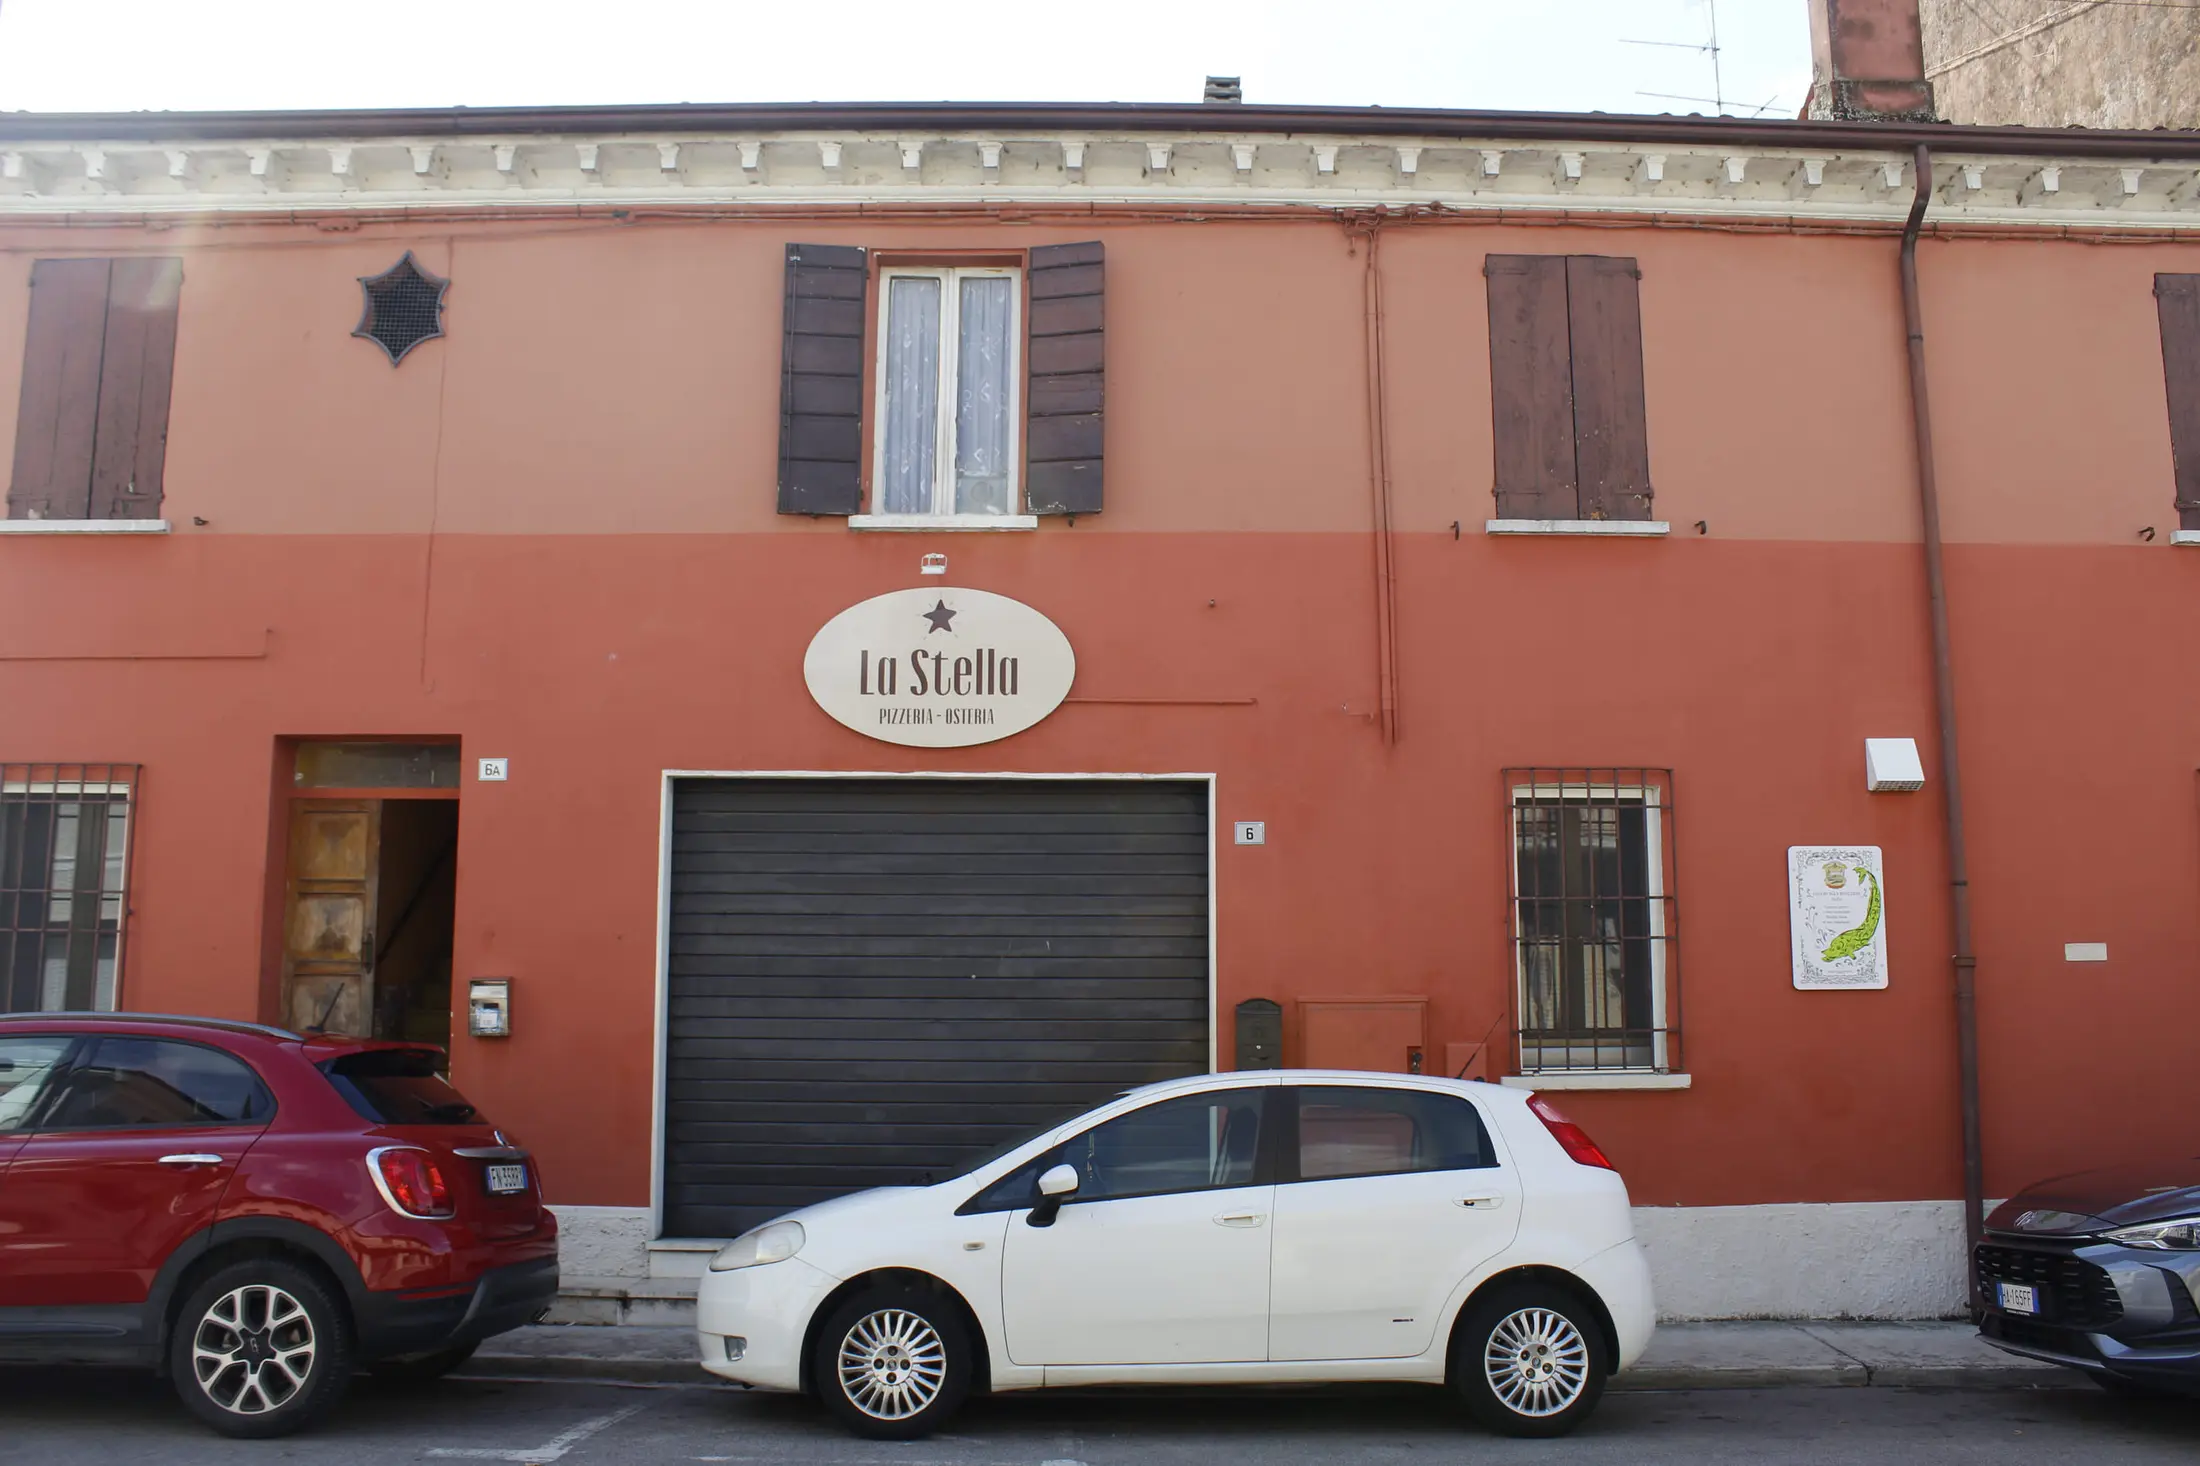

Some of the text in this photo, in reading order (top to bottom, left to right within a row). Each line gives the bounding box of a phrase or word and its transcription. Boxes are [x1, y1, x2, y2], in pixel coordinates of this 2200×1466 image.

[860, 648, 1018, 696] La Stella
[879, 708, 933, 725] PIZZERIA
[945, 708, 994, 725] OSTERIA
[485, 763, 500, 776] 6A
[1246, 827, 1254, 840] 6
